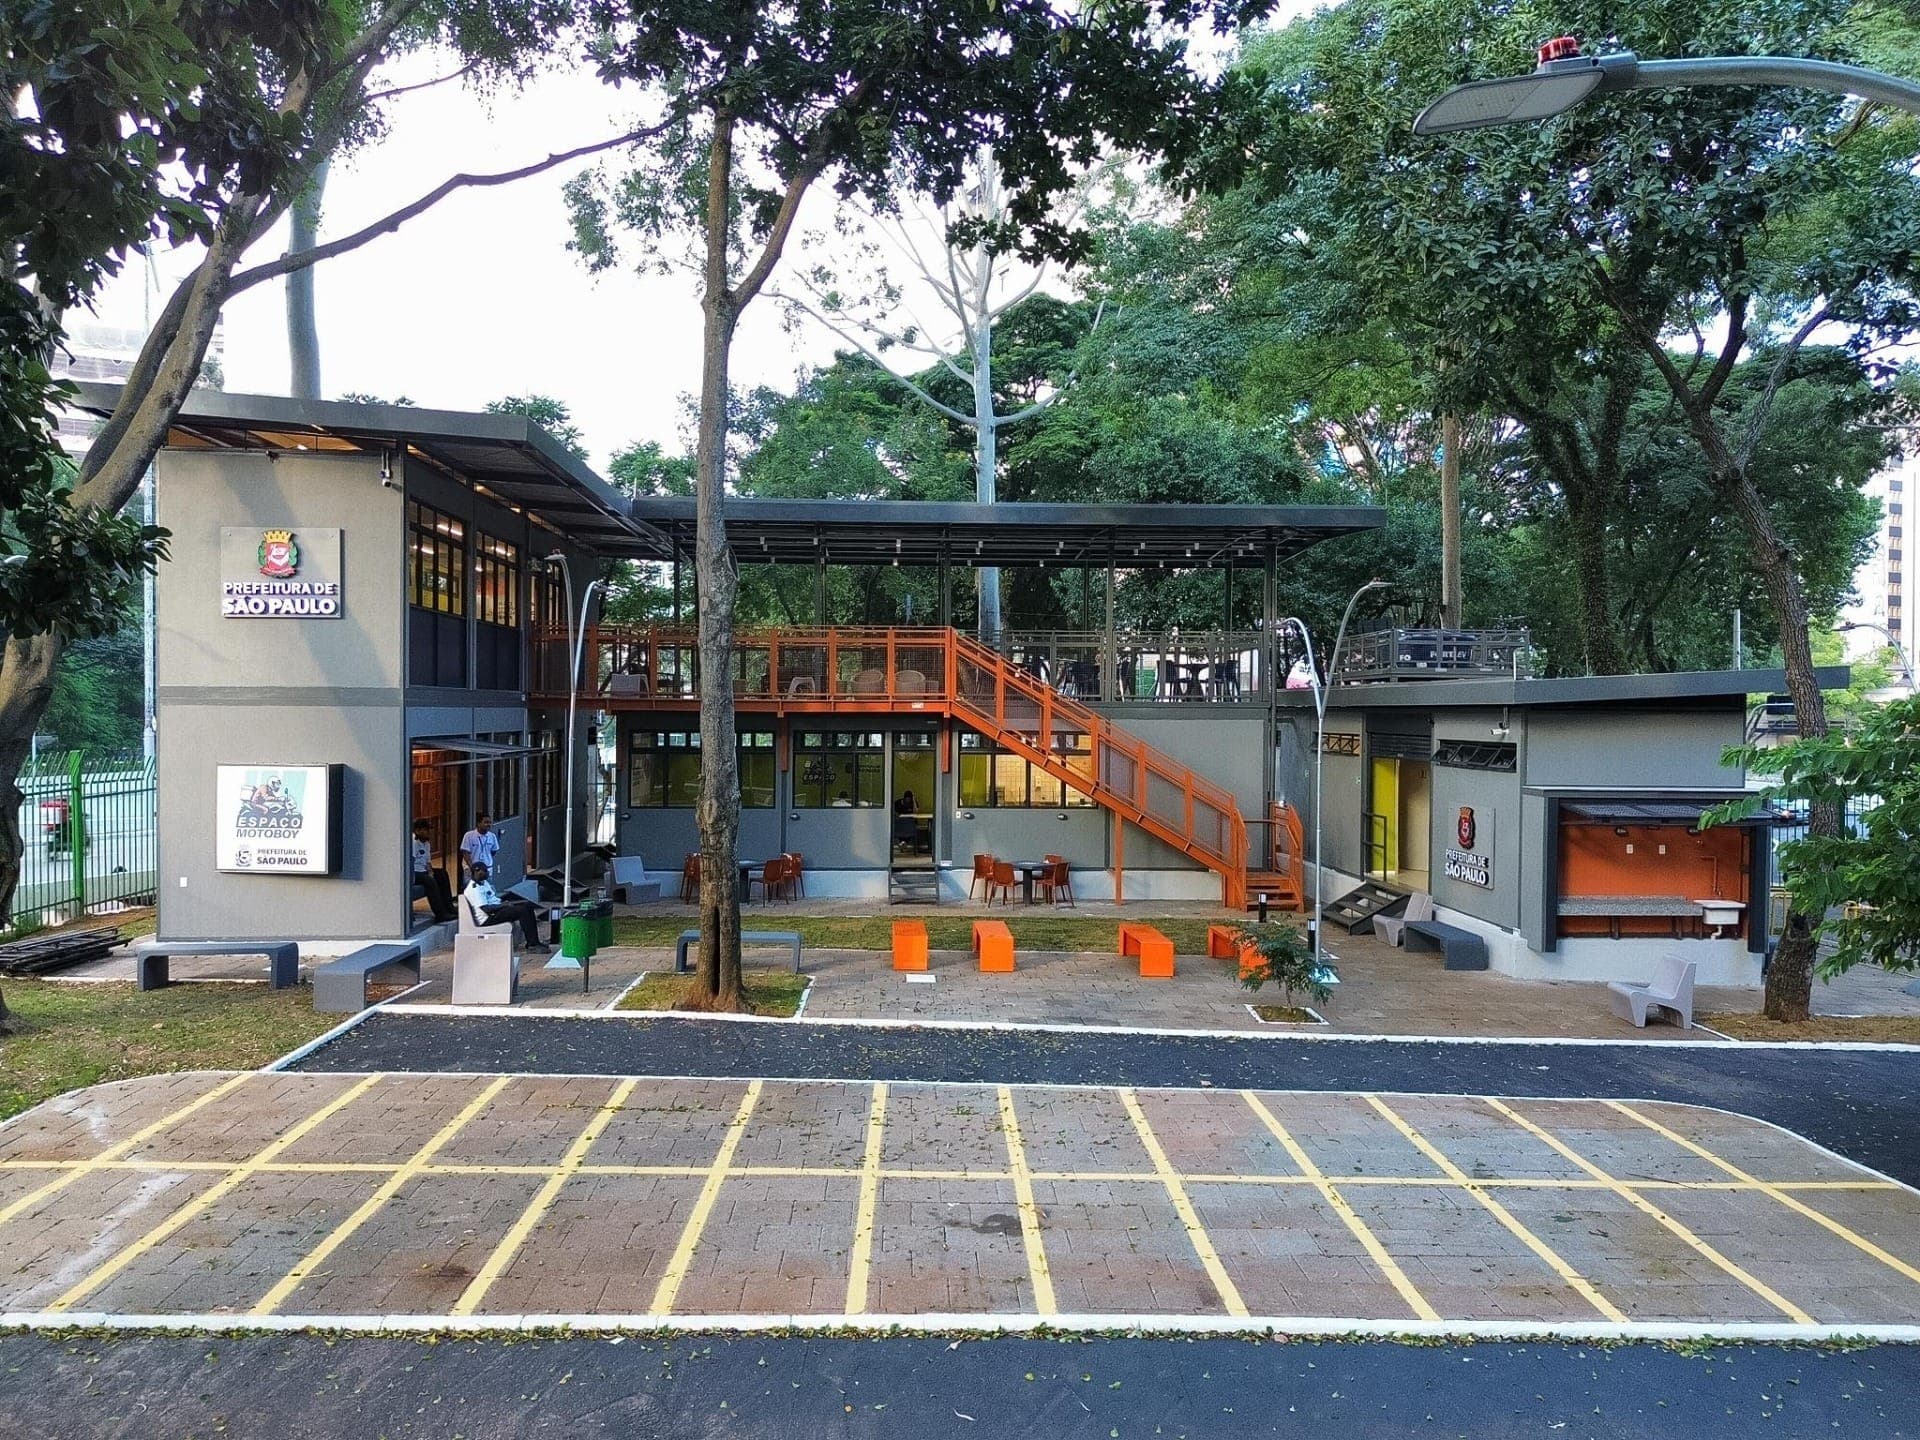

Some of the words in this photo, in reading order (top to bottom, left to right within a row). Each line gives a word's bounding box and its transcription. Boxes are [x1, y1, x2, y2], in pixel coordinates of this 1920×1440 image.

[224, 582, 311, 594] PREFEITURA
[314, 583, 335, 594] DE
[223, 595, 265, 614] SÃO
[269, 597, 336, 614] PAULO
[236, 829, 299, 839] MOTOBOY
[277, 857, 308, 865] PAULO
[1446, 849, 1477, 866] PREFEITURA
[1478, 856, 1486, 867] DE
[1445, 860, 1460, 877] SÃO
[1461, 866, 1486, 885] PAULO
